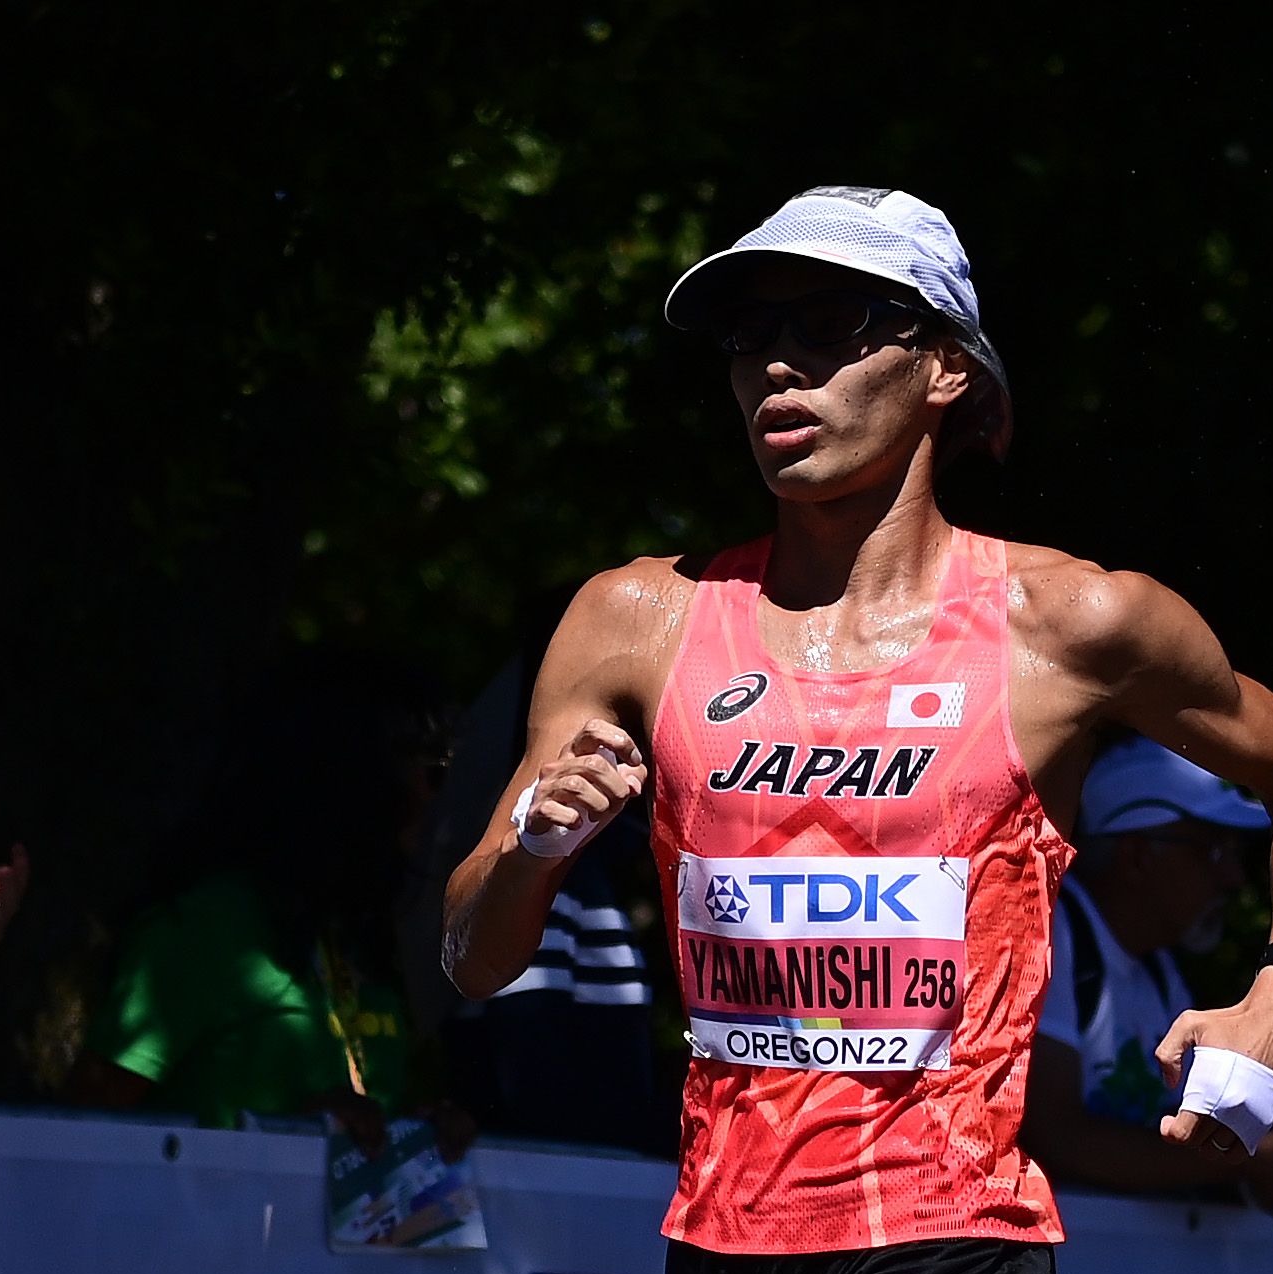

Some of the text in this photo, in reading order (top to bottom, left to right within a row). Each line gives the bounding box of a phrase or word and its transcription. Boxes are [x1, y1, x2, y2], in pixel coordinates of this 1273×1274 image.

[708, 740, 938, 799] JAPAN
[748, 873, 922, 924] TDK
[687, 938, 957, 1010] YAMANISHI 258
[726, 1030, 908, 1065] OREGON22
